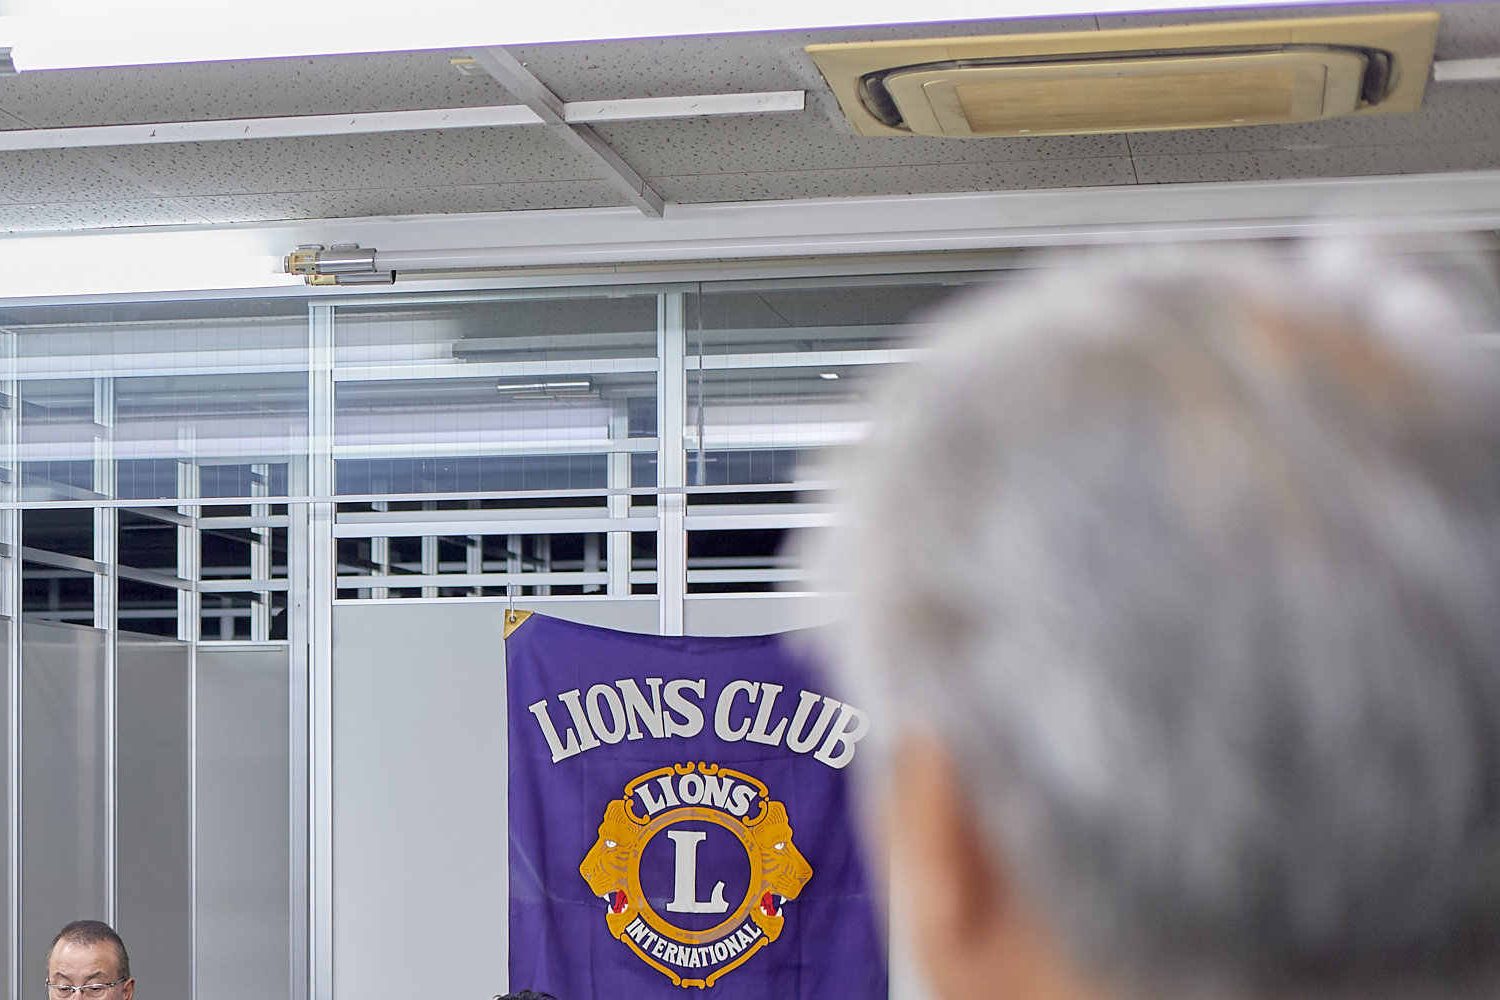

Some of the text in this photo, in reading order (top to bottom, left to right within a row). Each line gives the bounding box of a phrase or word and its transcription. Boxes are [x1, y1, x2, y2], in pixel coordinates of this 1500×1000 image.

[528, 677, 872, 770] LIONS CLUB
[634, 773, 758, 816] LIONS
[666, 829, 729, 913] L
[625, 918, 762, 968] INTERNATIONAL
